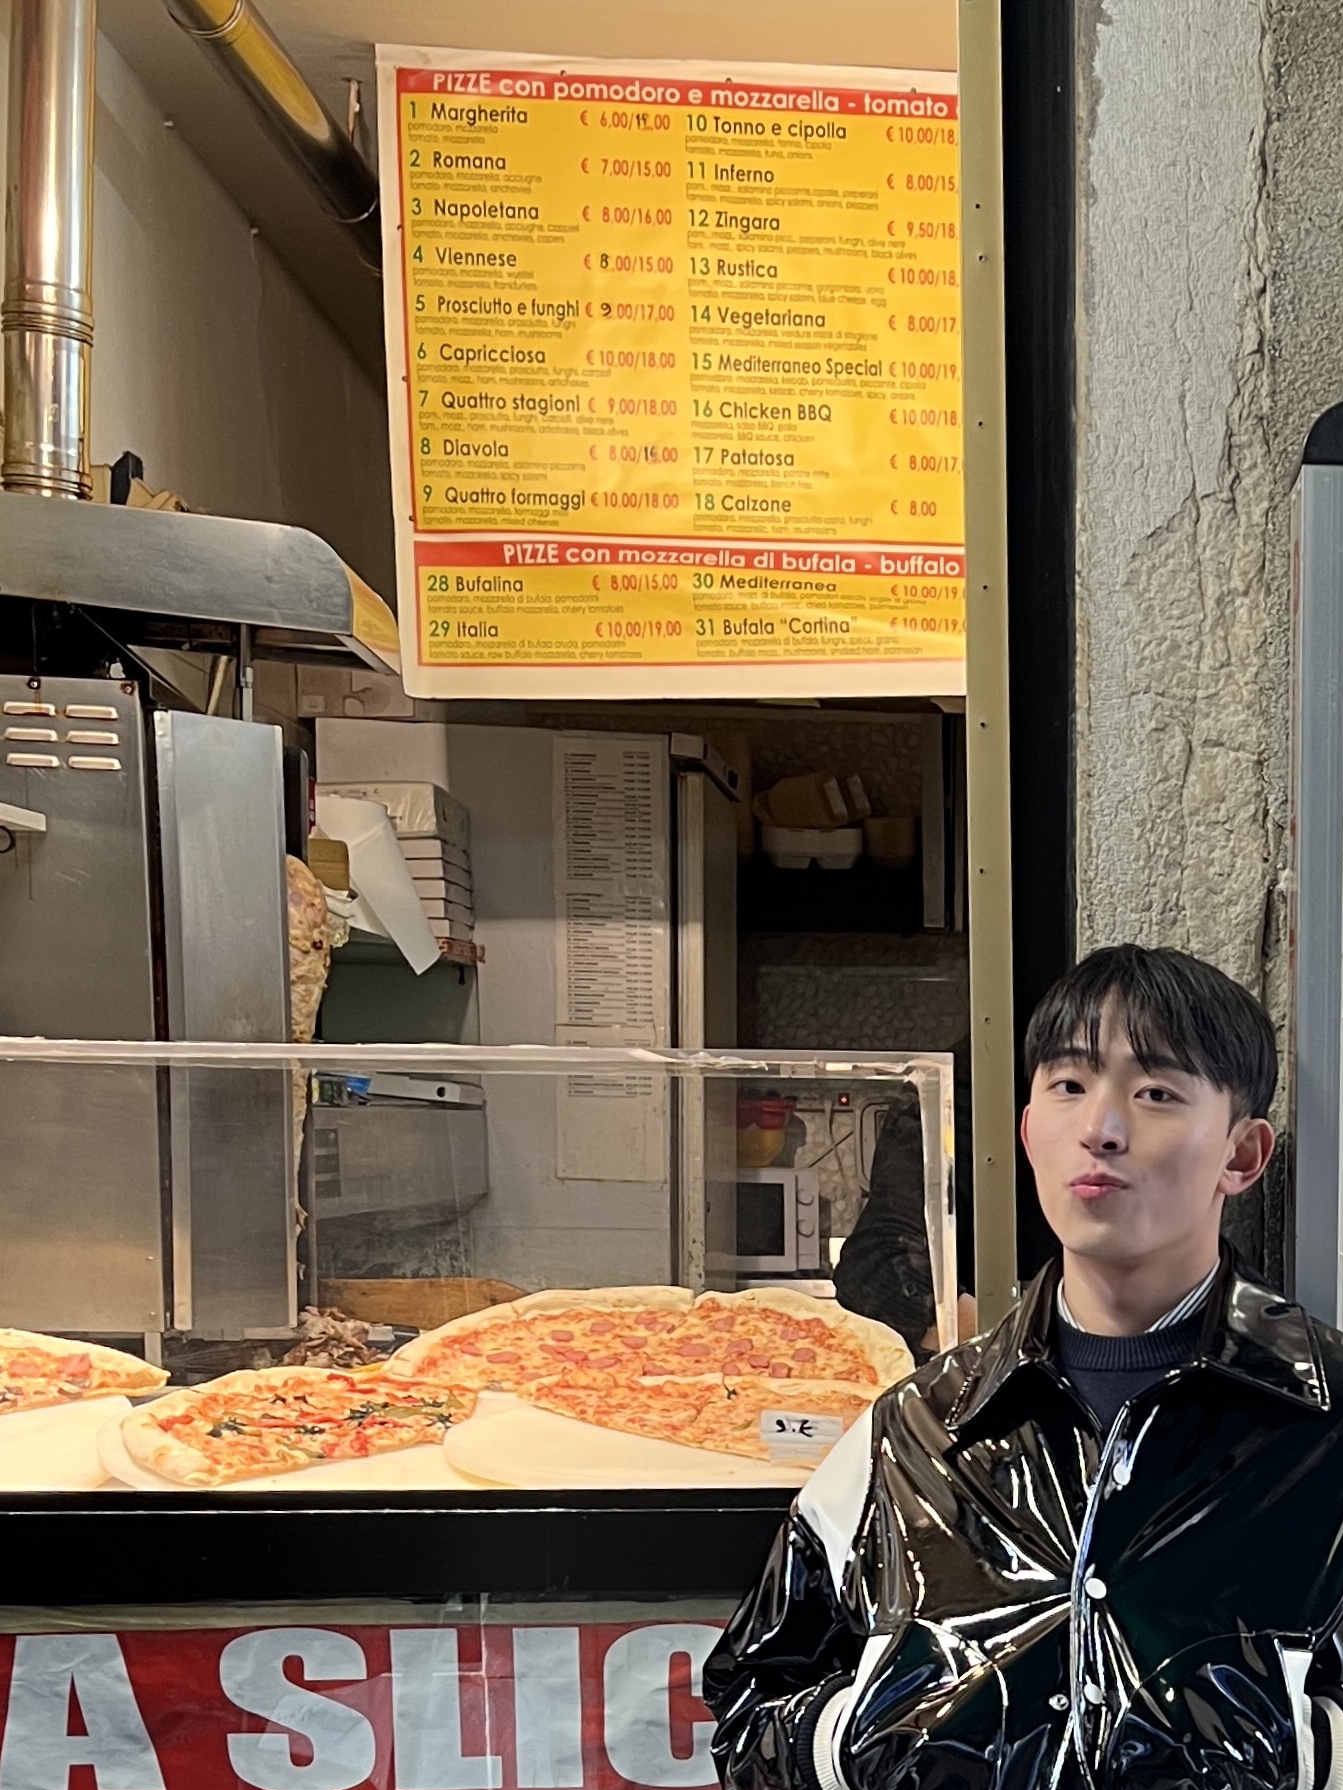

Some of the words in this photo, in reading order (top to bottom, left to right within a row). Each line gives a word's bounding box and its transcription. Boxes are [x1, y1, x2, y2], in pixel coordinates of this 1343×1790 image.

[434, 73, 491, 94] PIZZE
[498, 79, 545, 97] con
[554, 80, 680, 105] pomodoro
[688, 88, 703, 104] e
[711, 90, 839, 111] mozzarella
[864, 93, 948, 117] tomato
[410, 101, 416, 119] 1
[431, 102, 527, 128] Margherita
[687, 114, 707, 132] 10
[713, 116, 765, 135] Tonno
[771, 123, 782, 136] e
[788, 120, 846, 142] cipolla
[410, 149, 421, 167] 2
[433, 151, 506, 170] Romana
[411, 197, 422, 215] 3
[434, 199, 539, 223] Napoletana
[692, 352, 712, 370] 15
[718, 354, 821, 375] Mediterraneo
[826, 357, 882, 378] Special
[419, 390, 429, 407] 7
[441, 391, 506, 409] Quattro
[512, 393, 580, 416] stagioni
[693, 399, 713, 418] 16
[719, 401, 791, 420] Chicken
[798, 404, 831, 422] BBQ
[423, 485, 432, 502] 9
[445, 486, 506, 504] Quattro
[511, 487, 585, 513] formaggi
[695, 493, 715, 511] 18
[721, 494, 791, 513] Calzone
[503, 543, 559, 564] PIZZE
[565, 548, 610, 563] con
[619, 550, 745, 567] mozzarella
[753, 552, 774, 569] di
[782, 553, 855, 572] bufala
[880, 555, 960, 576] buffalo
[427, 574, 449, 592] 28
[456, 575, 523, 592] Bufalina
[693, 572, 714, 589] 30
[720, 574, 836, 592] Mediterranea
[429, 620, 450, 637] 29
[457, 621, 498, 638] Italia
[696, 618, 714, 636] 31
[723, 618, 774, 635] Bufala
